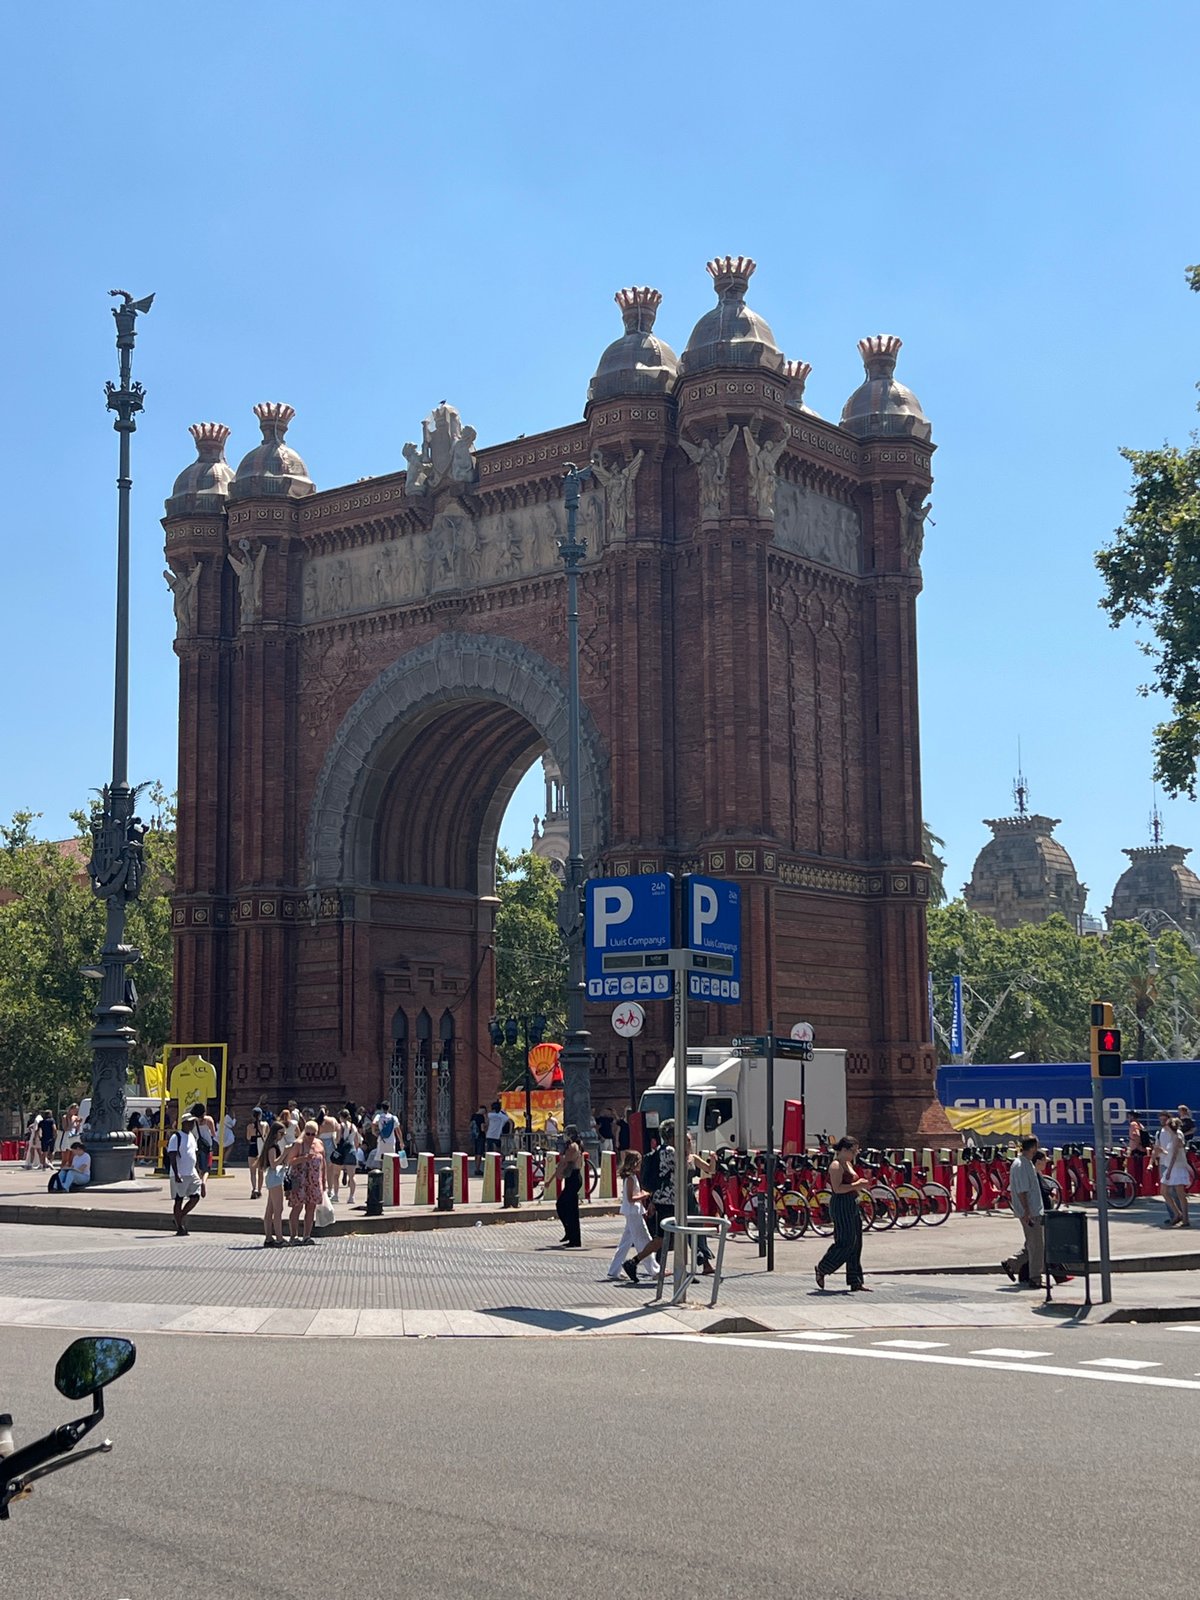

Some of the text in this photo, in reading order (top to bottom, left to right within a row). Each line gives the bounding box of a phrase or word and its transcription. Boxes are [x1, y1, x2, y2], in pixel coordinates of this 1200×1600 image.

[651, 882, 666, 891] 24h
[594, 886, 633, 948] P
[694, 883, 718, 945] P
[627, 936, 666, 948] Companys
